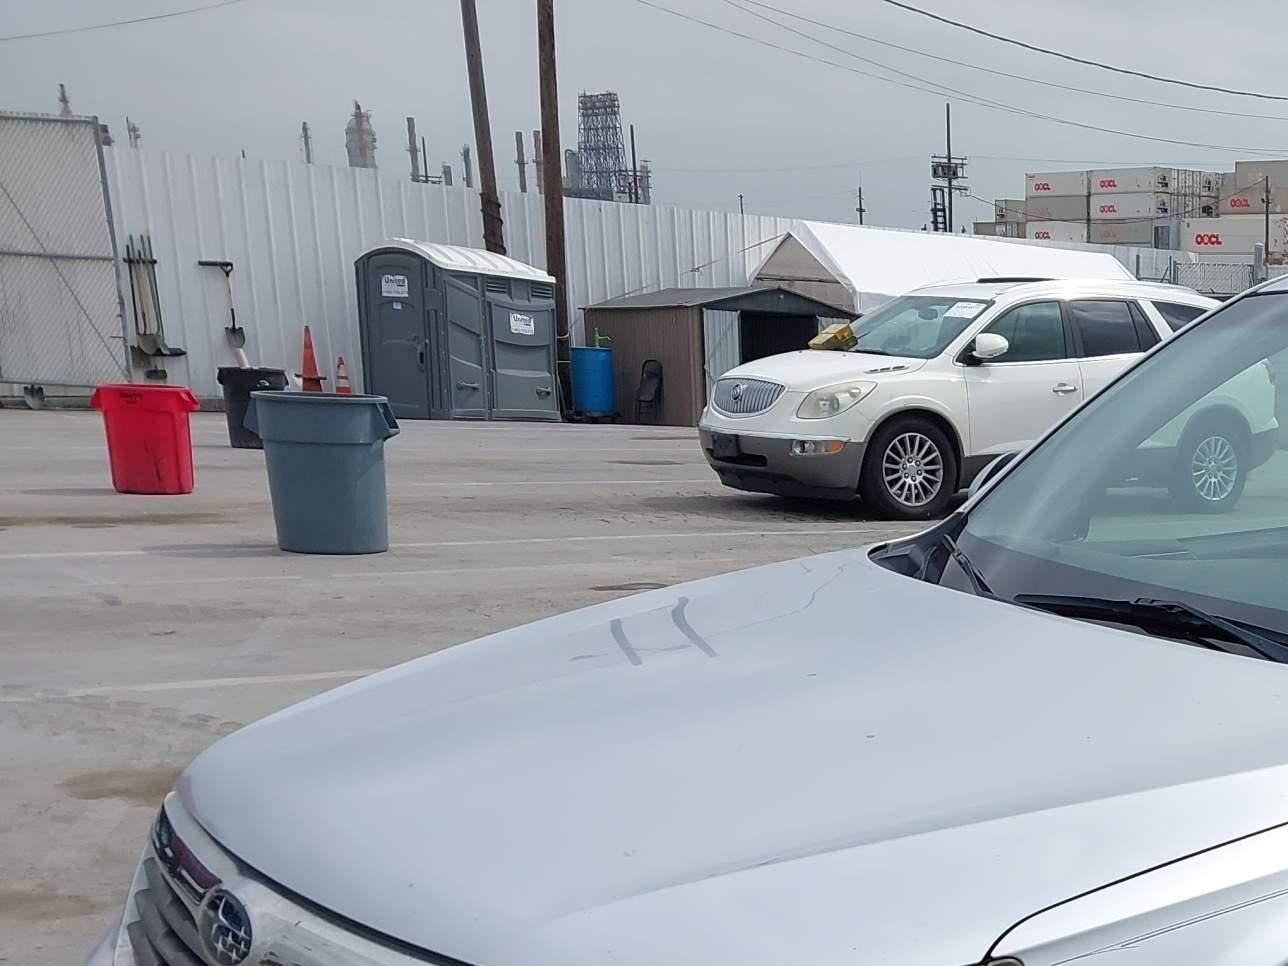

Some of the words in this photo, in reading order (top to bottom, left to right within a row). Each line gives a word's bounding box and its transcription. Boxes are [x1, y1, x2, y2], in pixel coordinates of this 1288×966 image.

[1035, 182, 1051, 191] OOCL
[1100, 179, 1117, 188] OOCL
[1230, 198, 1251, 208] OOCL
[1099, 204, 1117, 214] OOCL
[1035, 231, 1051, 240] OOCL
[1195, 233, 1223, 246] OOCL
